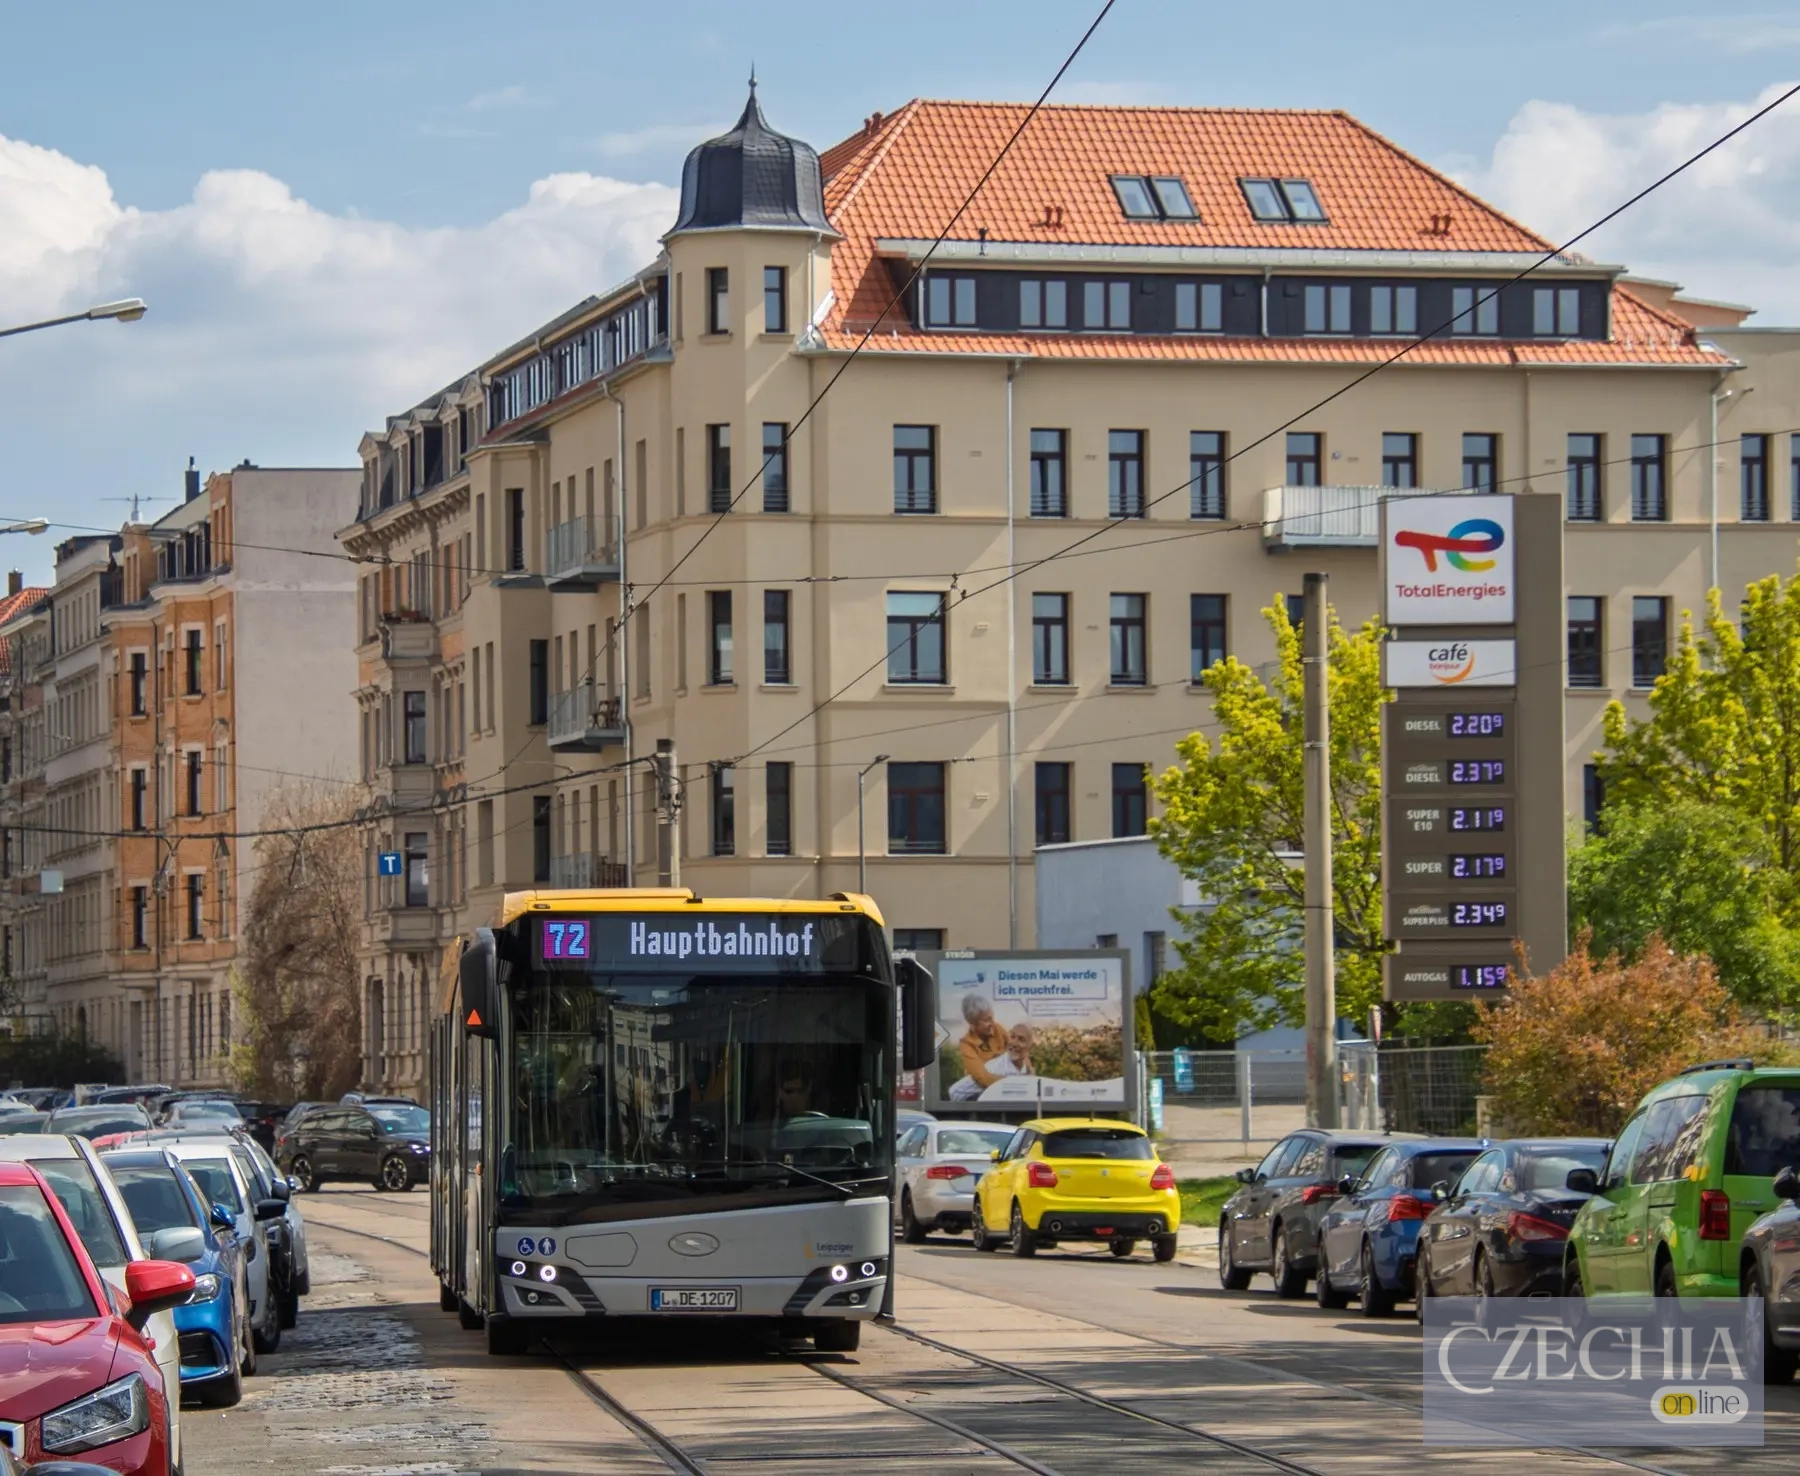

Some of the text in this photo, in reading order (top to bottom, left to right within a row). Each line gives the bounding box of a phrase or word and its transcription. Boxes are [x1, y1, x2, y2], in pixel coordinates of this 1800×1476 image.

[1395, 583, 1506, 600] TotalEnergies
[1428, 643, 1468, 661] café
[1405, 720, 1441, 731] DIESEL
[1405, 772, 1441, 783] DIESEL
[1406, 810, 1440, 820] SUPER
[1414, 821, 1433, 831] E10
[384, 856, 396, 873] T
[1405, 862, 1442, 874] SUPER
[548, 922, 813, 959] 72 Hauptbahnhof
[998, 969, 1098, 980] Diesen Mai werde
[1404, 973, 1448, 982] AUTOGAS
[998, 984, 1074, 995] ich rauchfrei.
[816, 1242, 854, 1253] Leipziger
